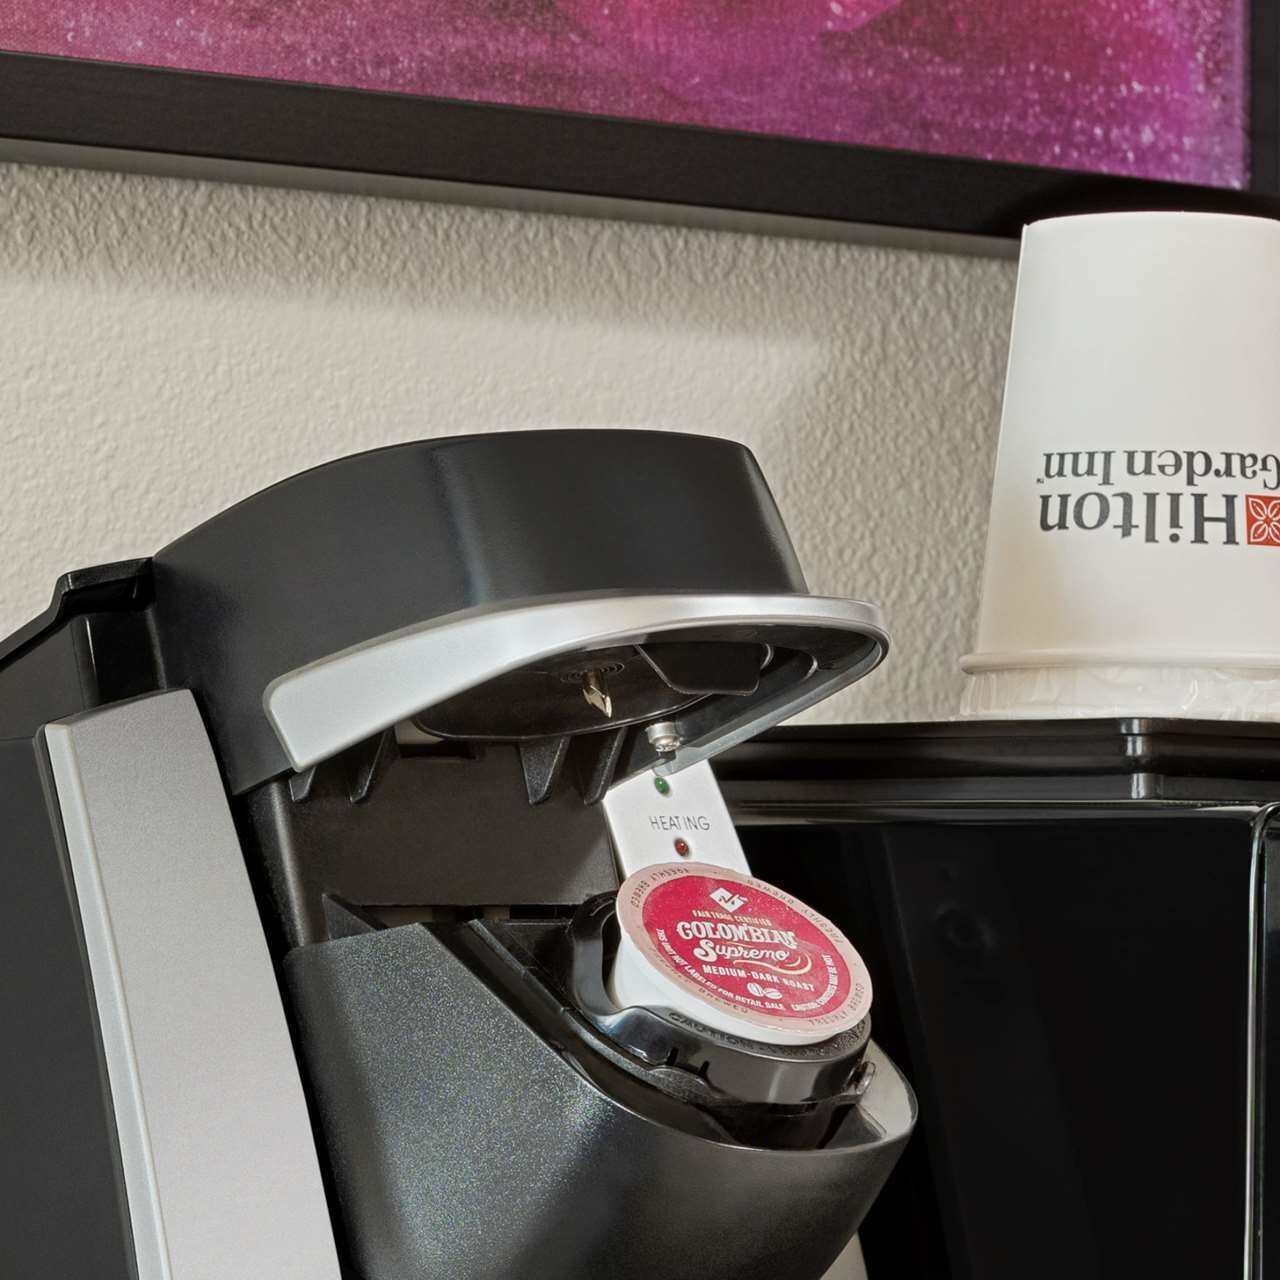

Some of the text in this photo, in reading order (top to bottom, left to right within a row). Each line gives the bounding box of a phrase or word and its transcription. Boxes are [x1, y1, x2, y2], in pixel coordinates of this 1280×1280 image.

[1042, 449, 1117, 486] Inn
[1038, 491, 1241, 546] Hilton
[649, 814, 712, 832] HEATING
[676, 920, 799, 949] COLOMBIAN
[693, 938, 790, 963] Supremo
[782, 978, 817, 993] ROAST
[718, 988, 735, 999] FOR
[765, 1001, 787, 1012] SALE
